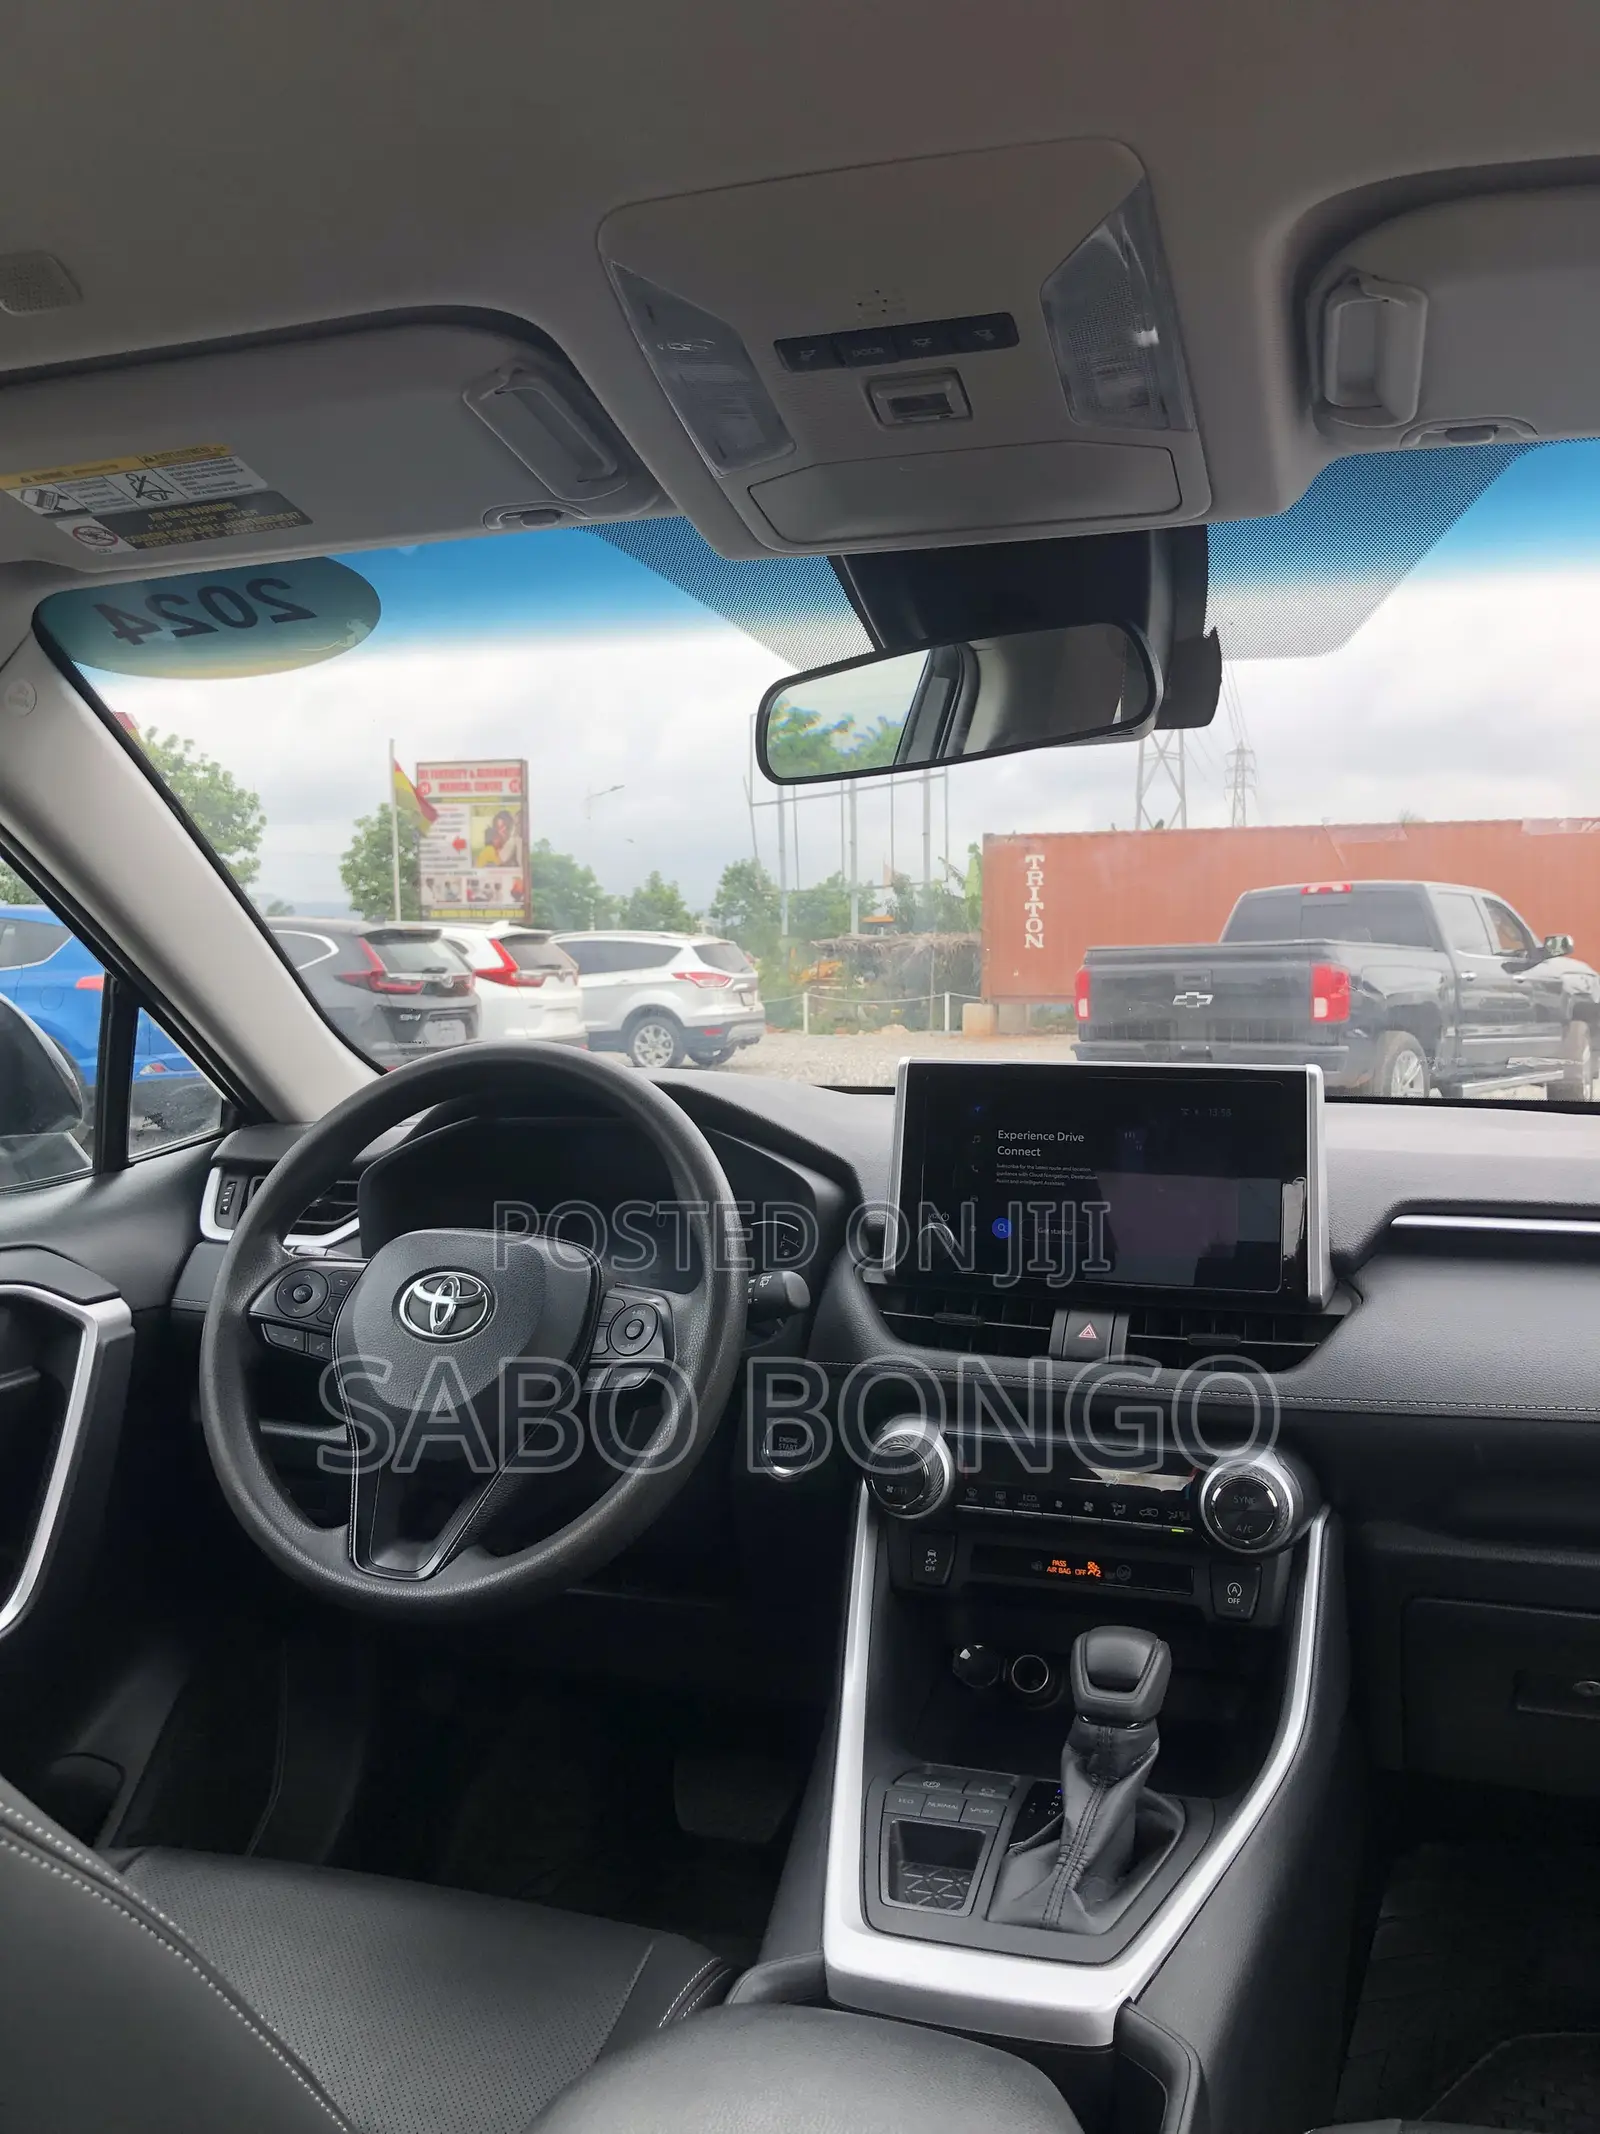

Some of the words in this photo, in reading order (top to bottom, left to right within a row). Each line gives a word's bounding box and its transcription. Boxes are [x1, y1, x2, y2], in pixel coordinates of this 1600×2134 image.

[1024, 854, 1046, 949] TRITON
[998, 1130, 1055, 1143] Experience
[1057, 1131, 1085, 1142] Drive
[997, 1145, 1042, 1157] Connect
[1233, 1495, 1257, 1504] SYNC
[1052, 1559, 1067, 1567] PASS
[1227, 1597, 1241, 1605] OFF
